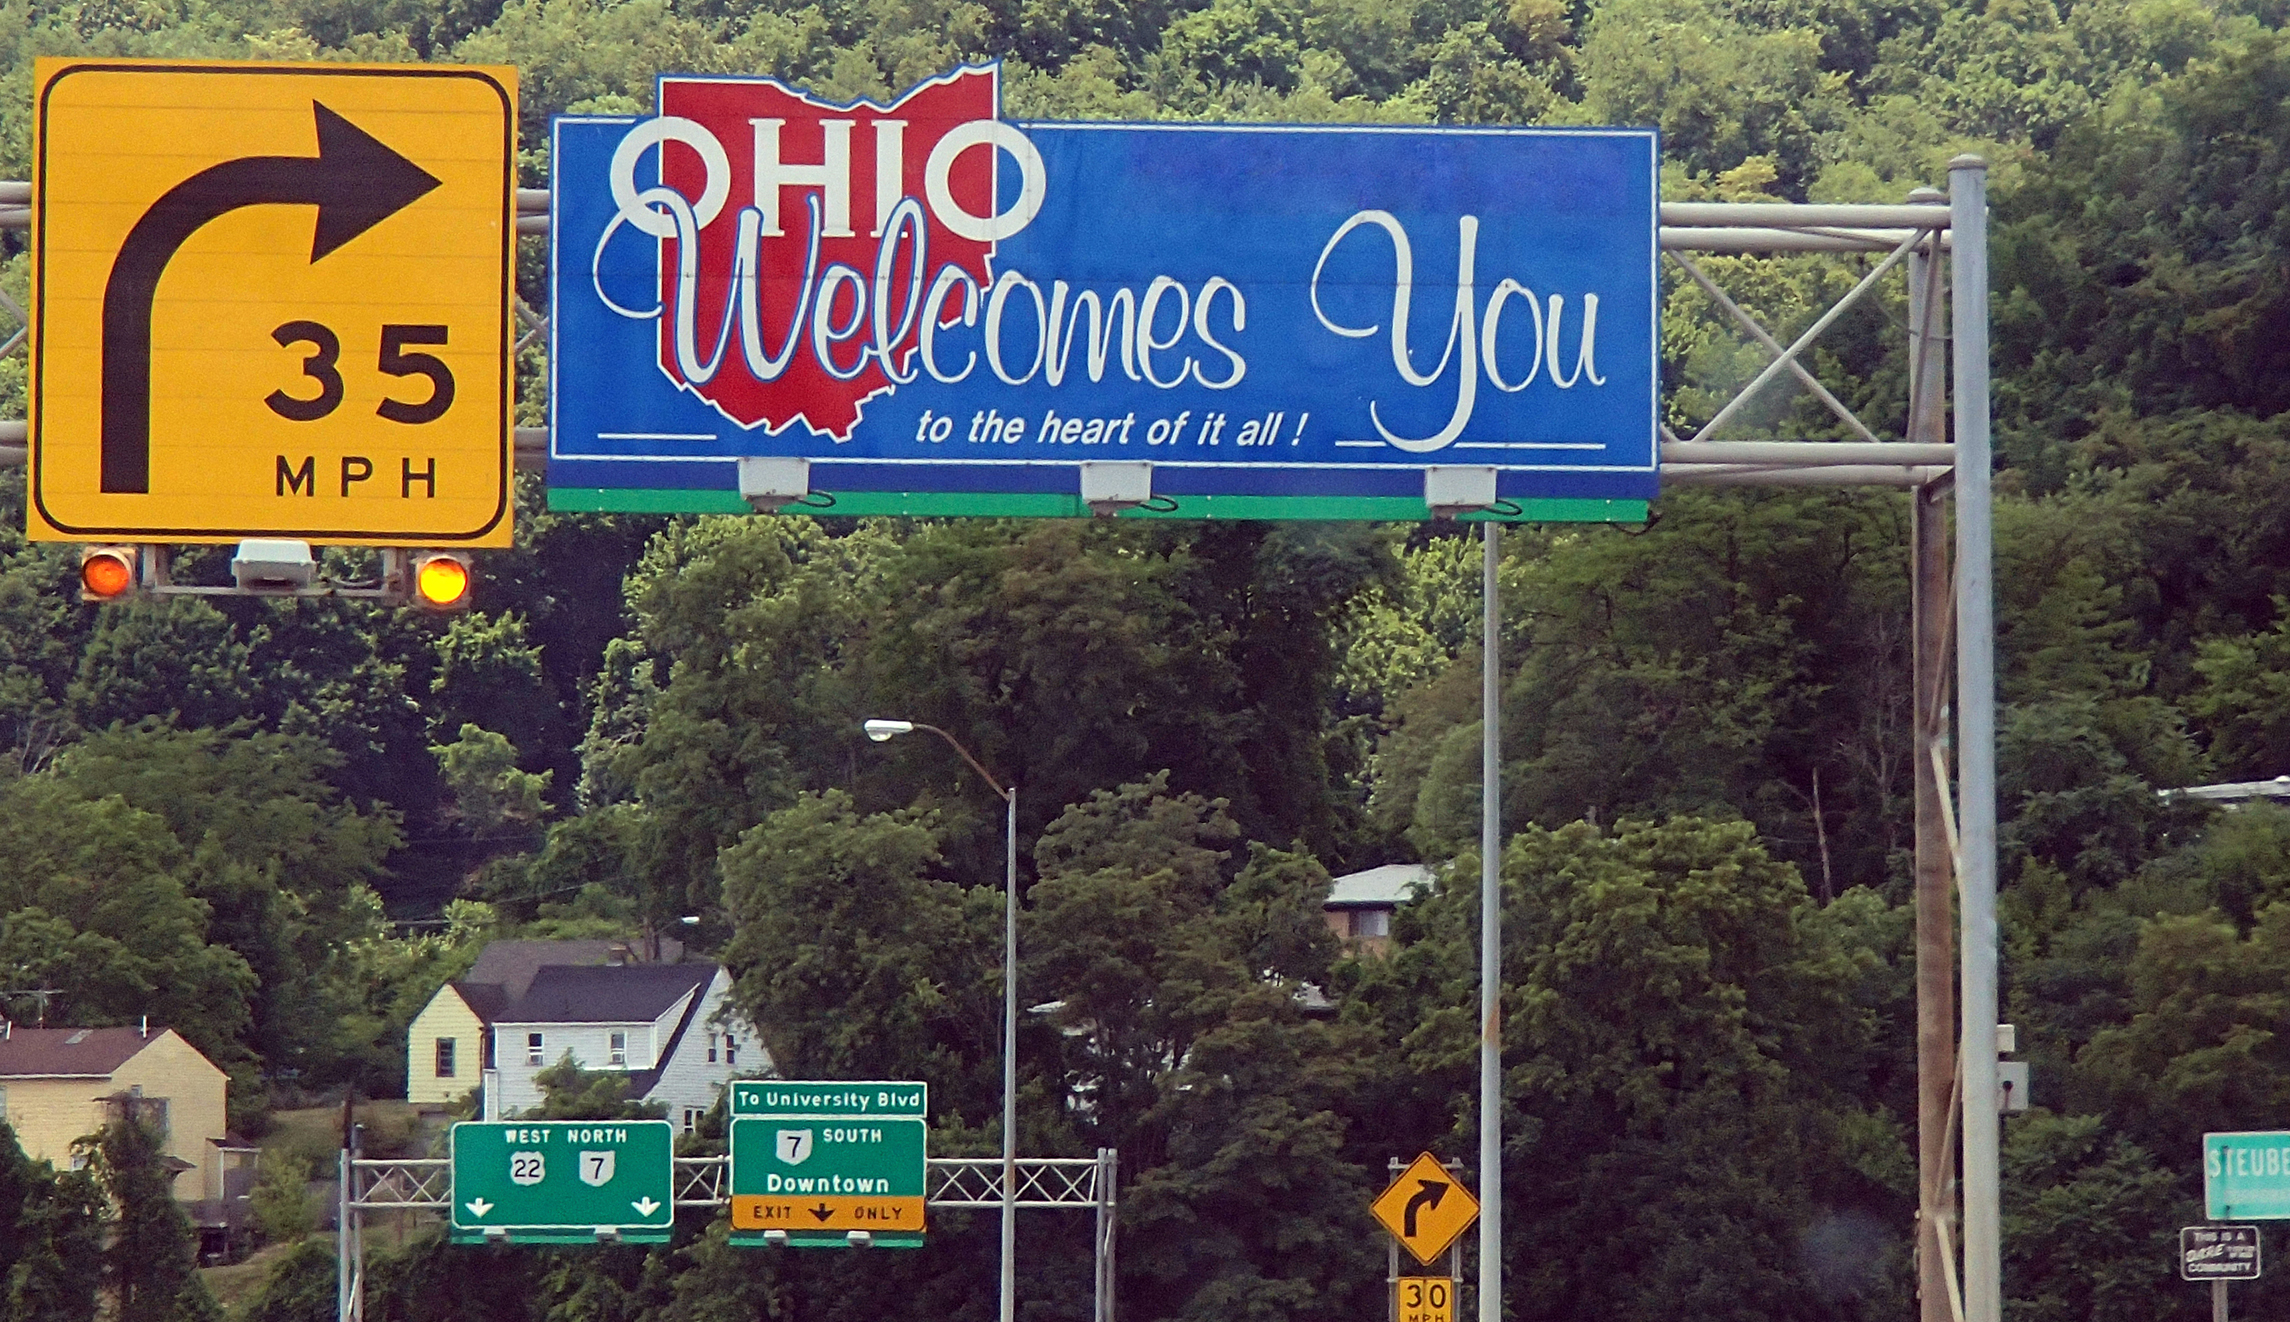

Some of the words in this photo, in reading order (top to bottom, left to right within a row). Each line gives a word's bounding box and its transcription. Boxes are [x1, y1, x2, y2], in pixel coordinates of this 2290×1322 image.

[610, 116, 1046, 241] OHIO
[593, 187, 1246, 389] Welcomes
[1312, 209, 1606, 452] You
[264, 320, 455, 424] 35
[915, 409, 953, 443] to
[968, 409, 1025, 444] the
[1036, 409, 1135, 444] heart
[1146, 410, 1191, 445] of
[1197, 412, 1226, 445] it
[1236, 412, 1284, 446] all
[276, 455, 435, 498] MPH
[738, 1091, 760, 1106] To
[766, 1091, 870, 1112] University
[877, 1092, 920, 1107] Blvd
[505, 1129, 551, 1144] WEST
[567, 1129, 628, 1144] NORTH
[786, 1136, 802, 1158] 7
[822, 1128, 883, 1143] SOUTH
[514, 1159, 541, 1178] 22
[590, 1157, 604, 1180] 7
[767, 1173, 890, 1193] Downtown
[753, 1205, 791, 1219] EXIT
[854, 1206, 902, 1220] ONLY
[1406, 1284, 1447, 1309] 30
